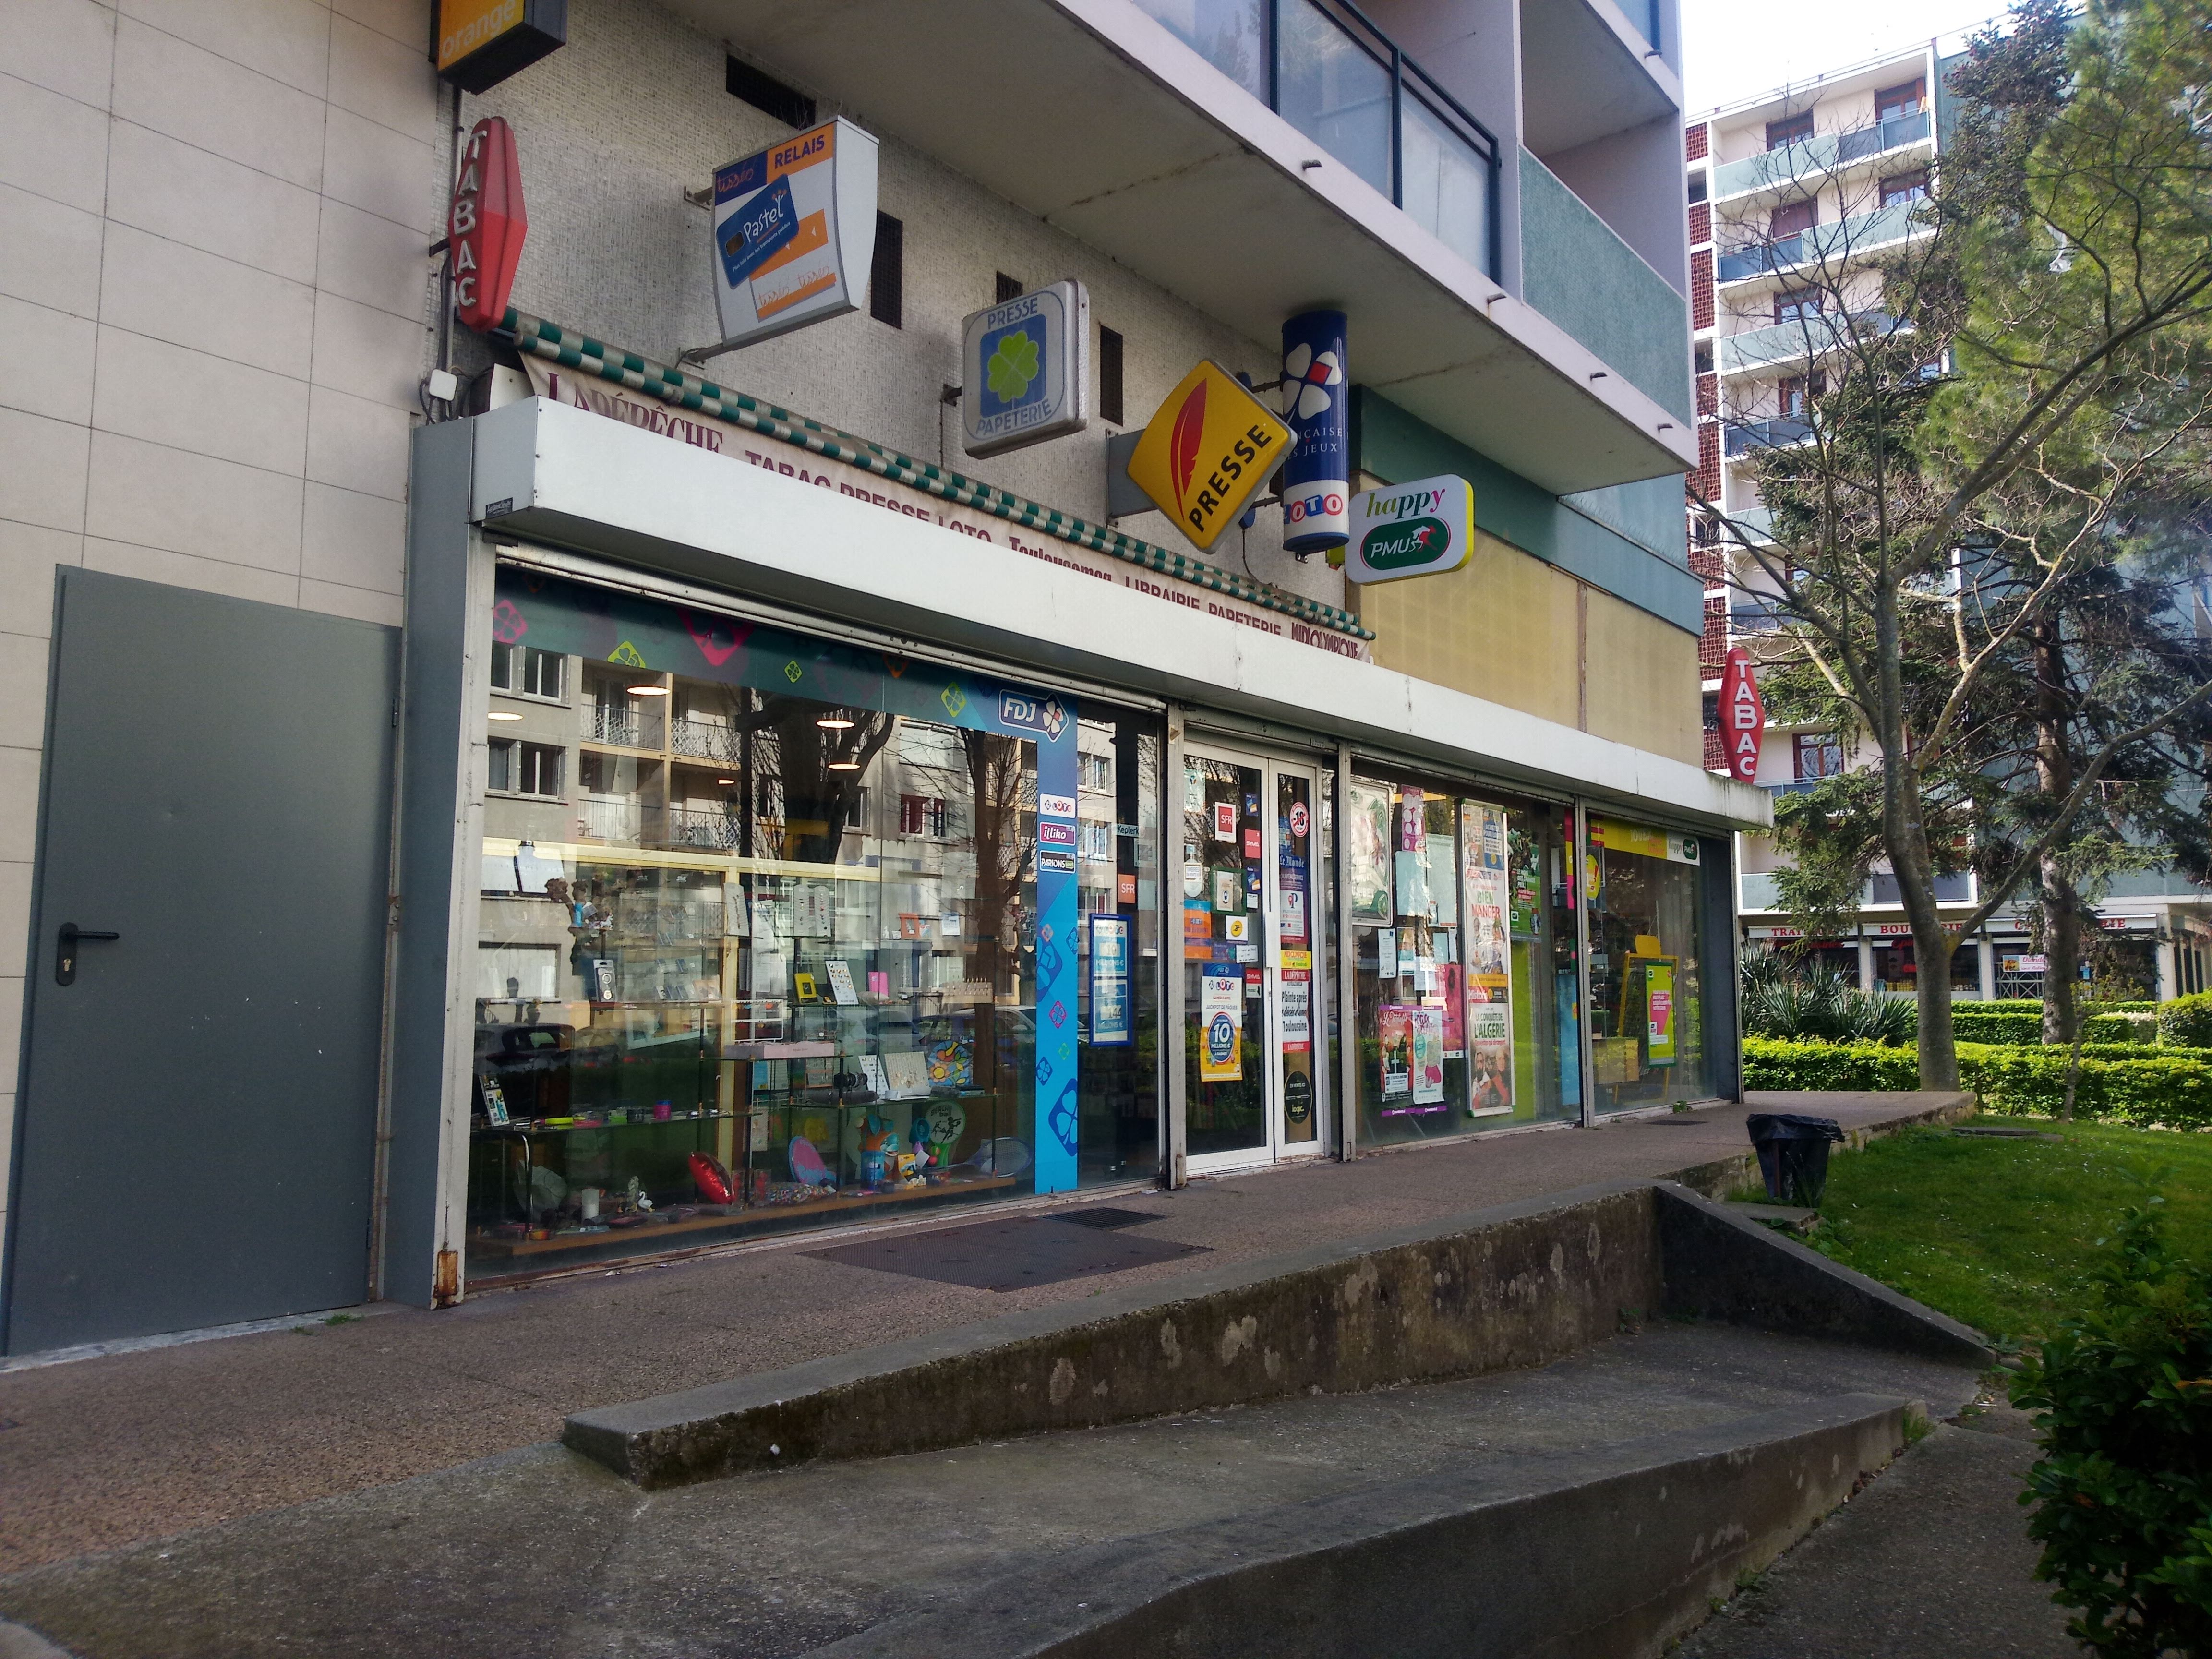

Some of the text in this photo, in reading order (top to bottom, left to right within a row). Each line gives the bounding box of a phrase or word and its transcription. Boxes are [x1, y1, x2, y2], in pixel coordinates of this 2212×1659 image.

[441, 0, 516, 58] orange
[775, 135, 824, 169] RELAIS
[454, 130, 487, 307] TABAC
[743, 194, 784, 243] Pastel
[760, 232, 778, 249] transports
[778, 221, 791, 236] publics
[987, 296, 1039, 330] PRESSE
[975, 399, 1053, 437] PAPETERIE
[1304, 444, 1338, 457] JEUX
[1188, 422, 1272, 533] PRESSE
[1366, 489, 1446, 520] happy
[1370, 537, 1410, 559] PMU
[1003, 697, 1037, 723] FDJ
[1734, 660, 1758, 775] TABAC
[1052, 800, 1072, 812] LOTO
[1221, 814, 1232, 825] SFR
[1044, 826, 1067, 840] illiko
[1117, 825, 1139, 835] Keplerk
[1041, 858, 1065, 868] PARIONS
[1280, 855, 1304, 868] Le Monde
[1121, 883, 1135, 894] SFR
[1471, 904, 1501, 918] MANGER
[1216, 979, 1235, 990] LOTO
[1282, 991, 1307, 1005] Plainte après
[1481, 1011, 1498, 1022] CONQUÊTE
[1213, 1023, 1230, 1043] 10
[1283, 1020, 1307, 1032] Toulousaine
[1475, 1022, 1505, 1038] L'ALGÉRIE
